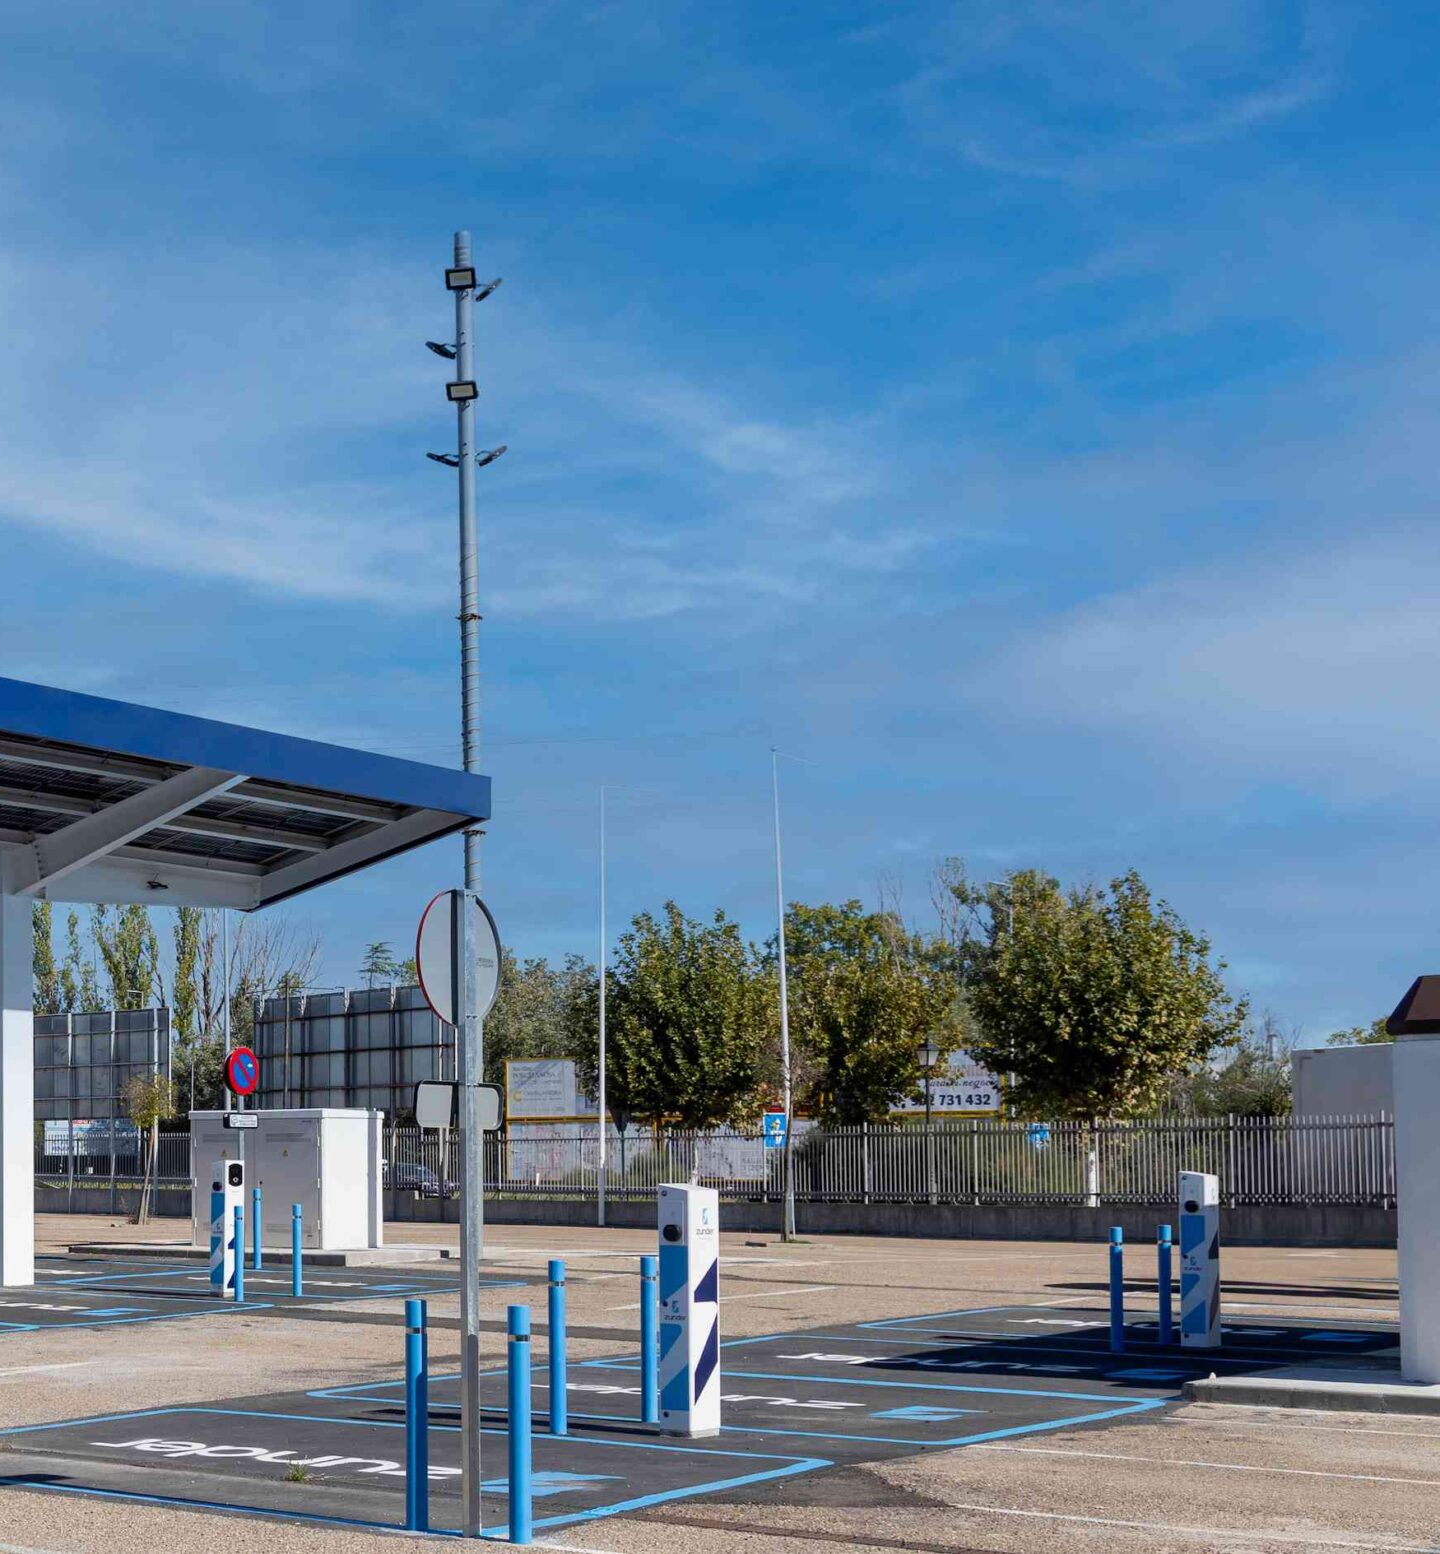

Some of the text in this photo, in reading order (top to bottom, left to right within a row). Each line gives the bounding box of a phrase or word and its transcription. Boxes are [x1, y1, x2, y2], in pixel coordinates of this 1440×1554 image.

[939, 1094, 962, 1106] 731
[965, 1094, 991, 1106] 432
[776, 1352, 1098, 1372] zunder
[90, 1438, 465, 1481] zunder
